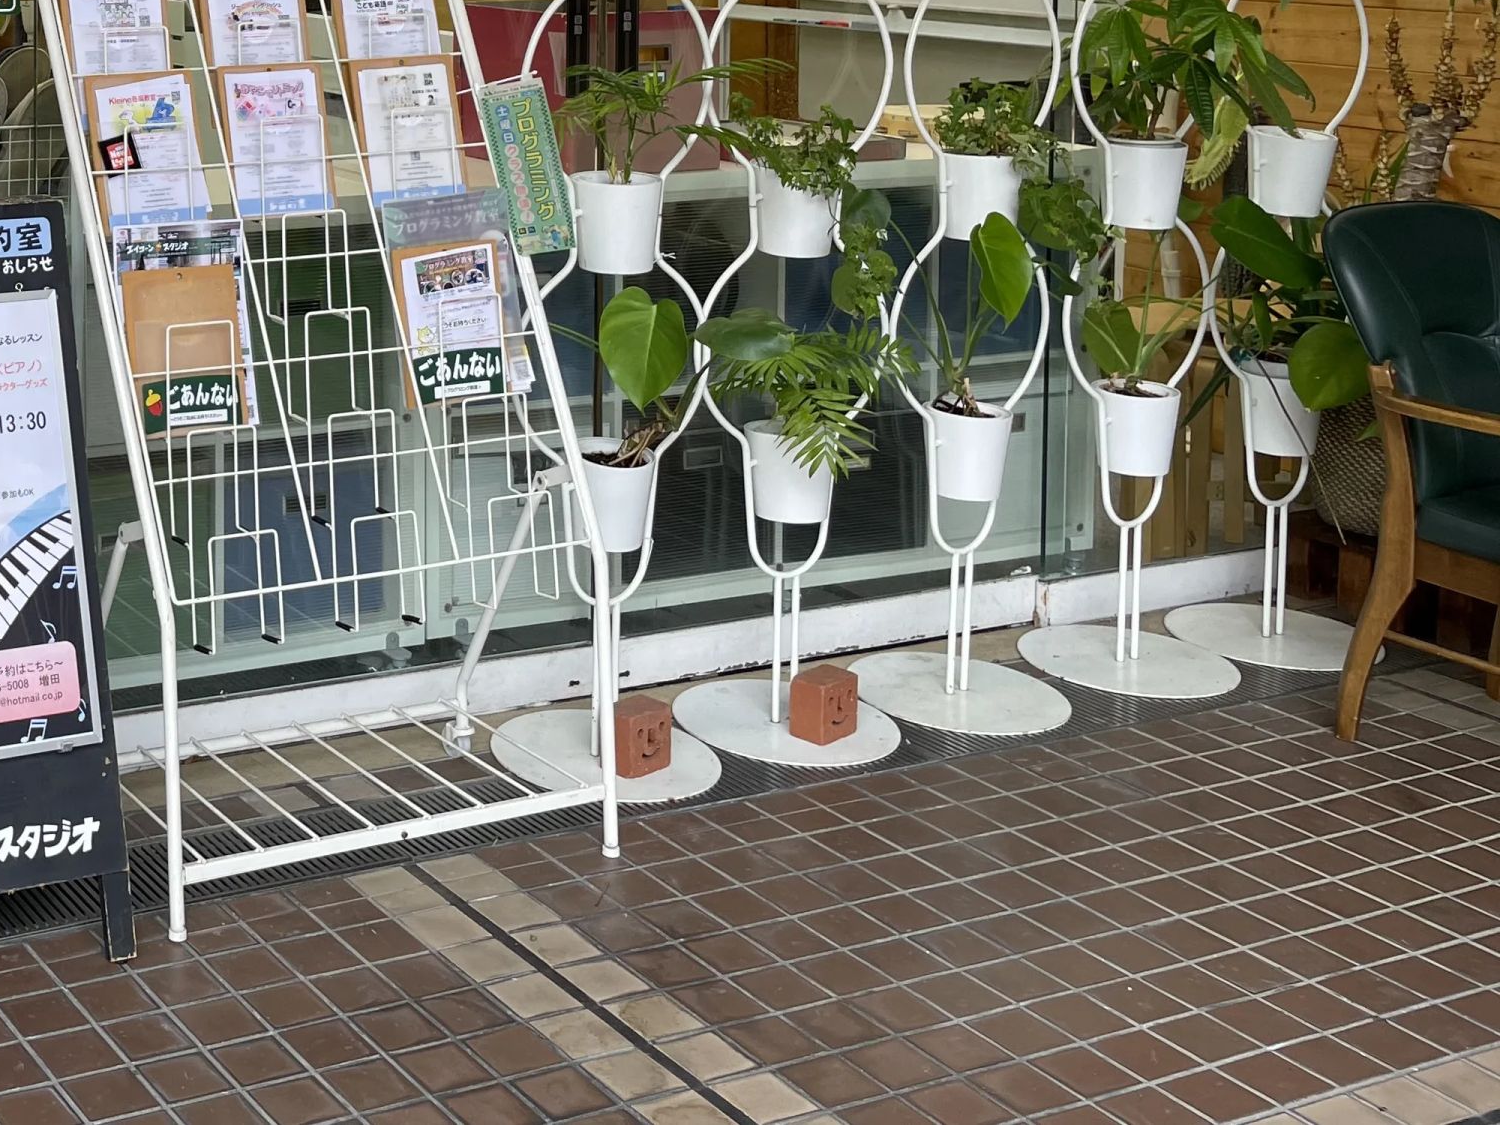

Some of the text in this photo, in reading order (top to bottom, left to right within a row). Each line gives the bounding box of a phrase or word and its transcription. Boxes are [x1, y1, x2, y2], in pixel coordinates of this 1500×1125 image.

[512, 97, 556, 221] プログラミング
[2, 255, 54, 274] おしらせ
[418, 350, 501, 387] ごあんない
[168, 382, 239, 410] ごあんない
[38, 673, 61, 687] 増田
